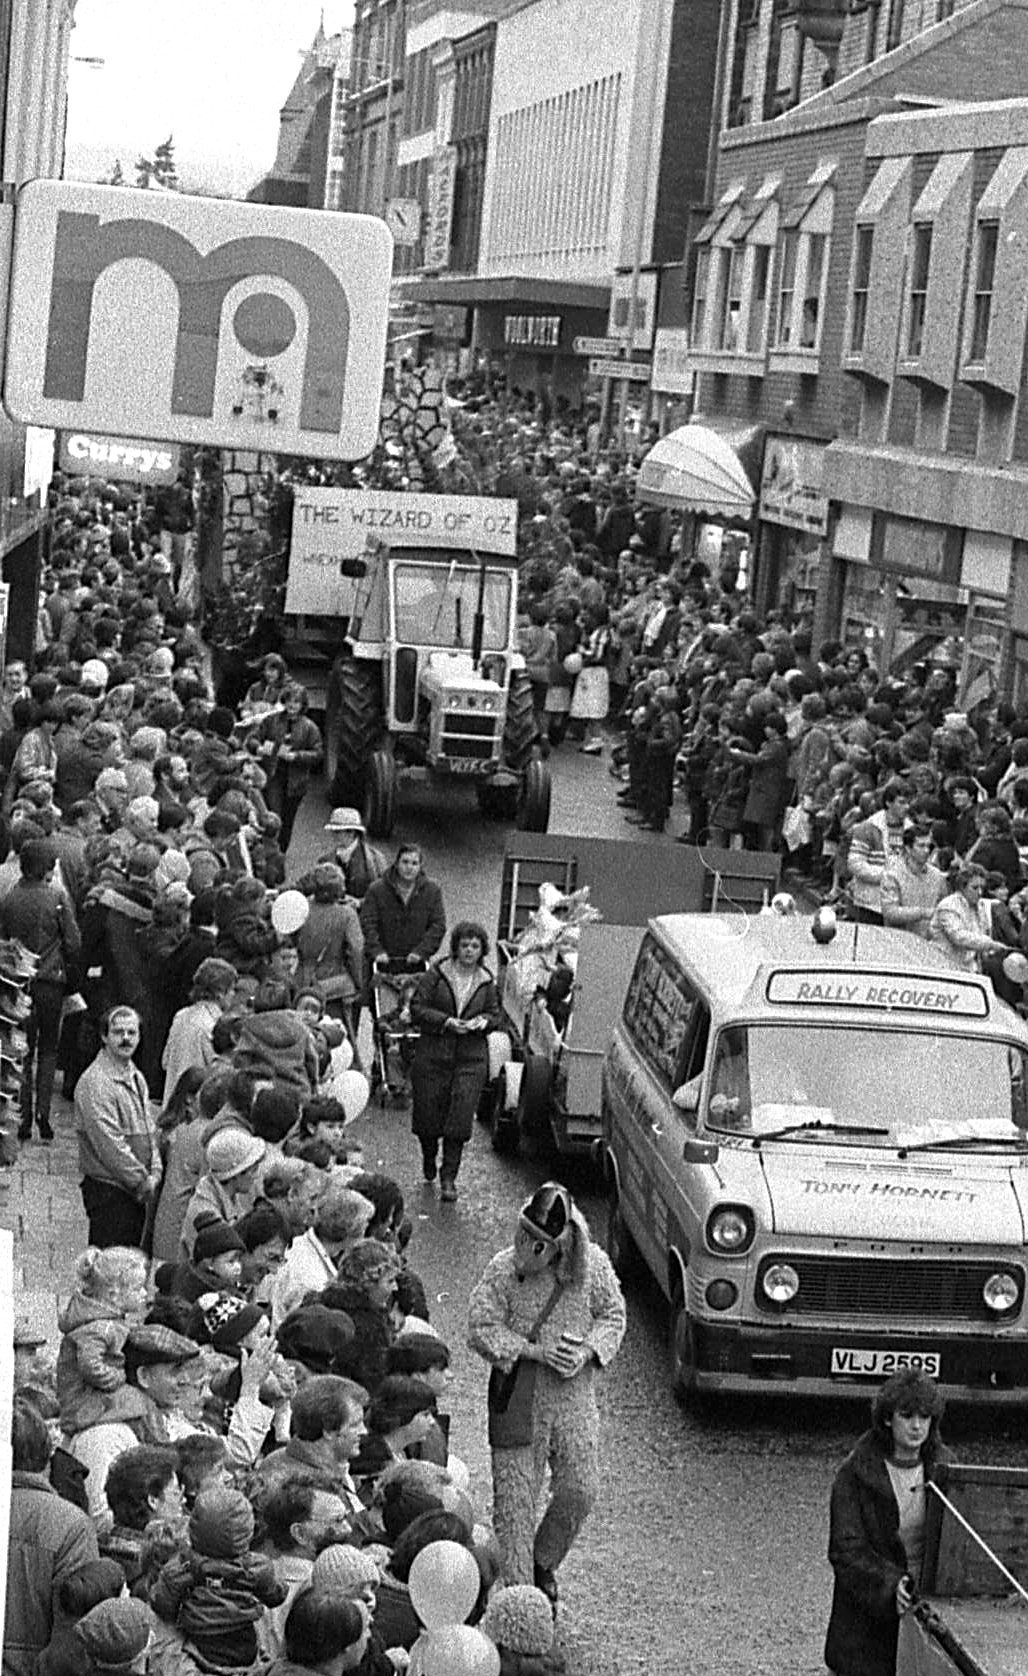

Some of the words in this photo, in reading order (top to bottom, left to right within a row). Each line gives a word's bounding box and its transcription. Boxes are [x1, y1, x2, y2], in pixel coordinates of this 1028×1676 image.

[66, 434, 173, 472] Currys
[300, 504, 339, 524] THE
[351, 507, 432, 529] WIZARD
[444, 512, 472, 531] OF
[484, 515, 511, 535] OZ
[797, 982, 859, 1001] RALLY
[866, 986, 960, 1010] RECOVERY
[835, 1351, 878, 1372] VLJ
